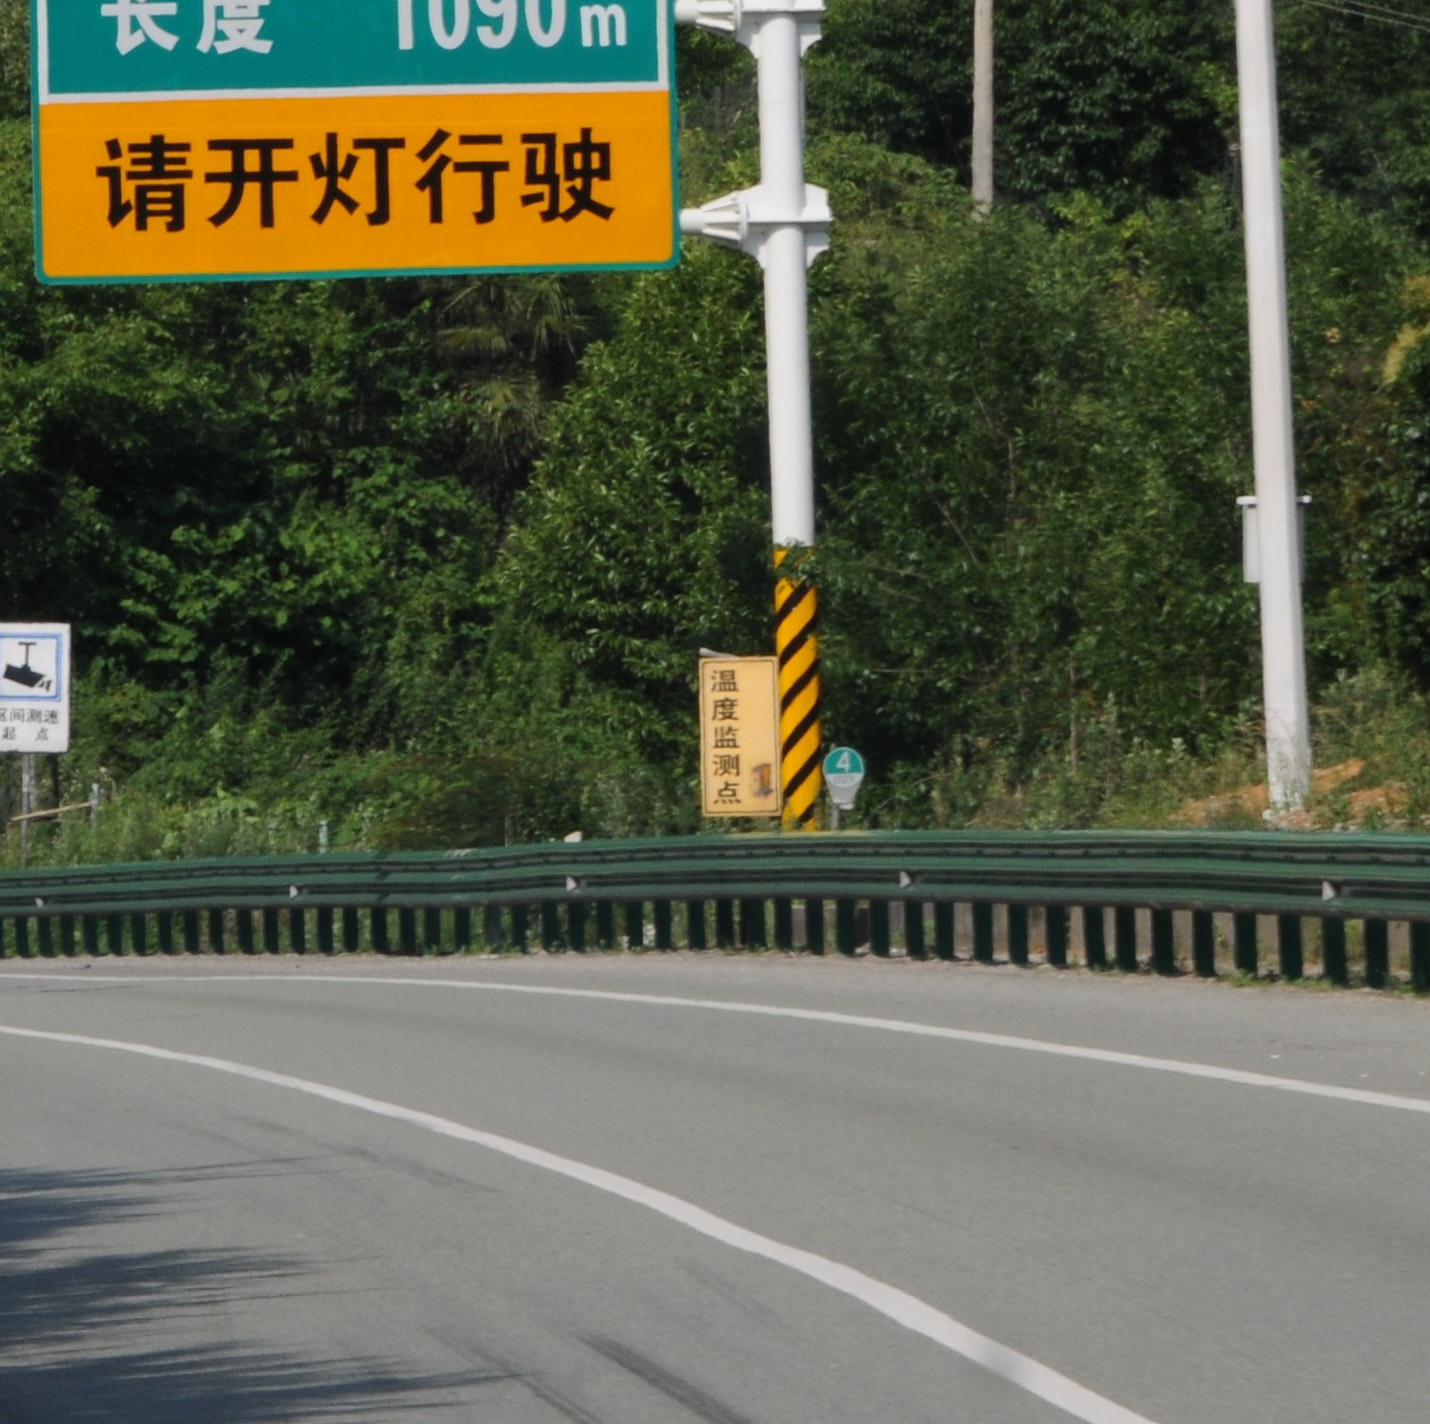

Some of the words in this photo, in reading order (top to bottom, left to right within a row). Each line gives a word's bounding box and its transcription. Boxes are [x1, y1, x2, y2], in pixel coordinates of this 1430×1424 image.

[95, 127, 616, 233] 请开灯行驶
[710, 669, 742, 805] 温度监测点
[836, 751, 851, 773] 4
